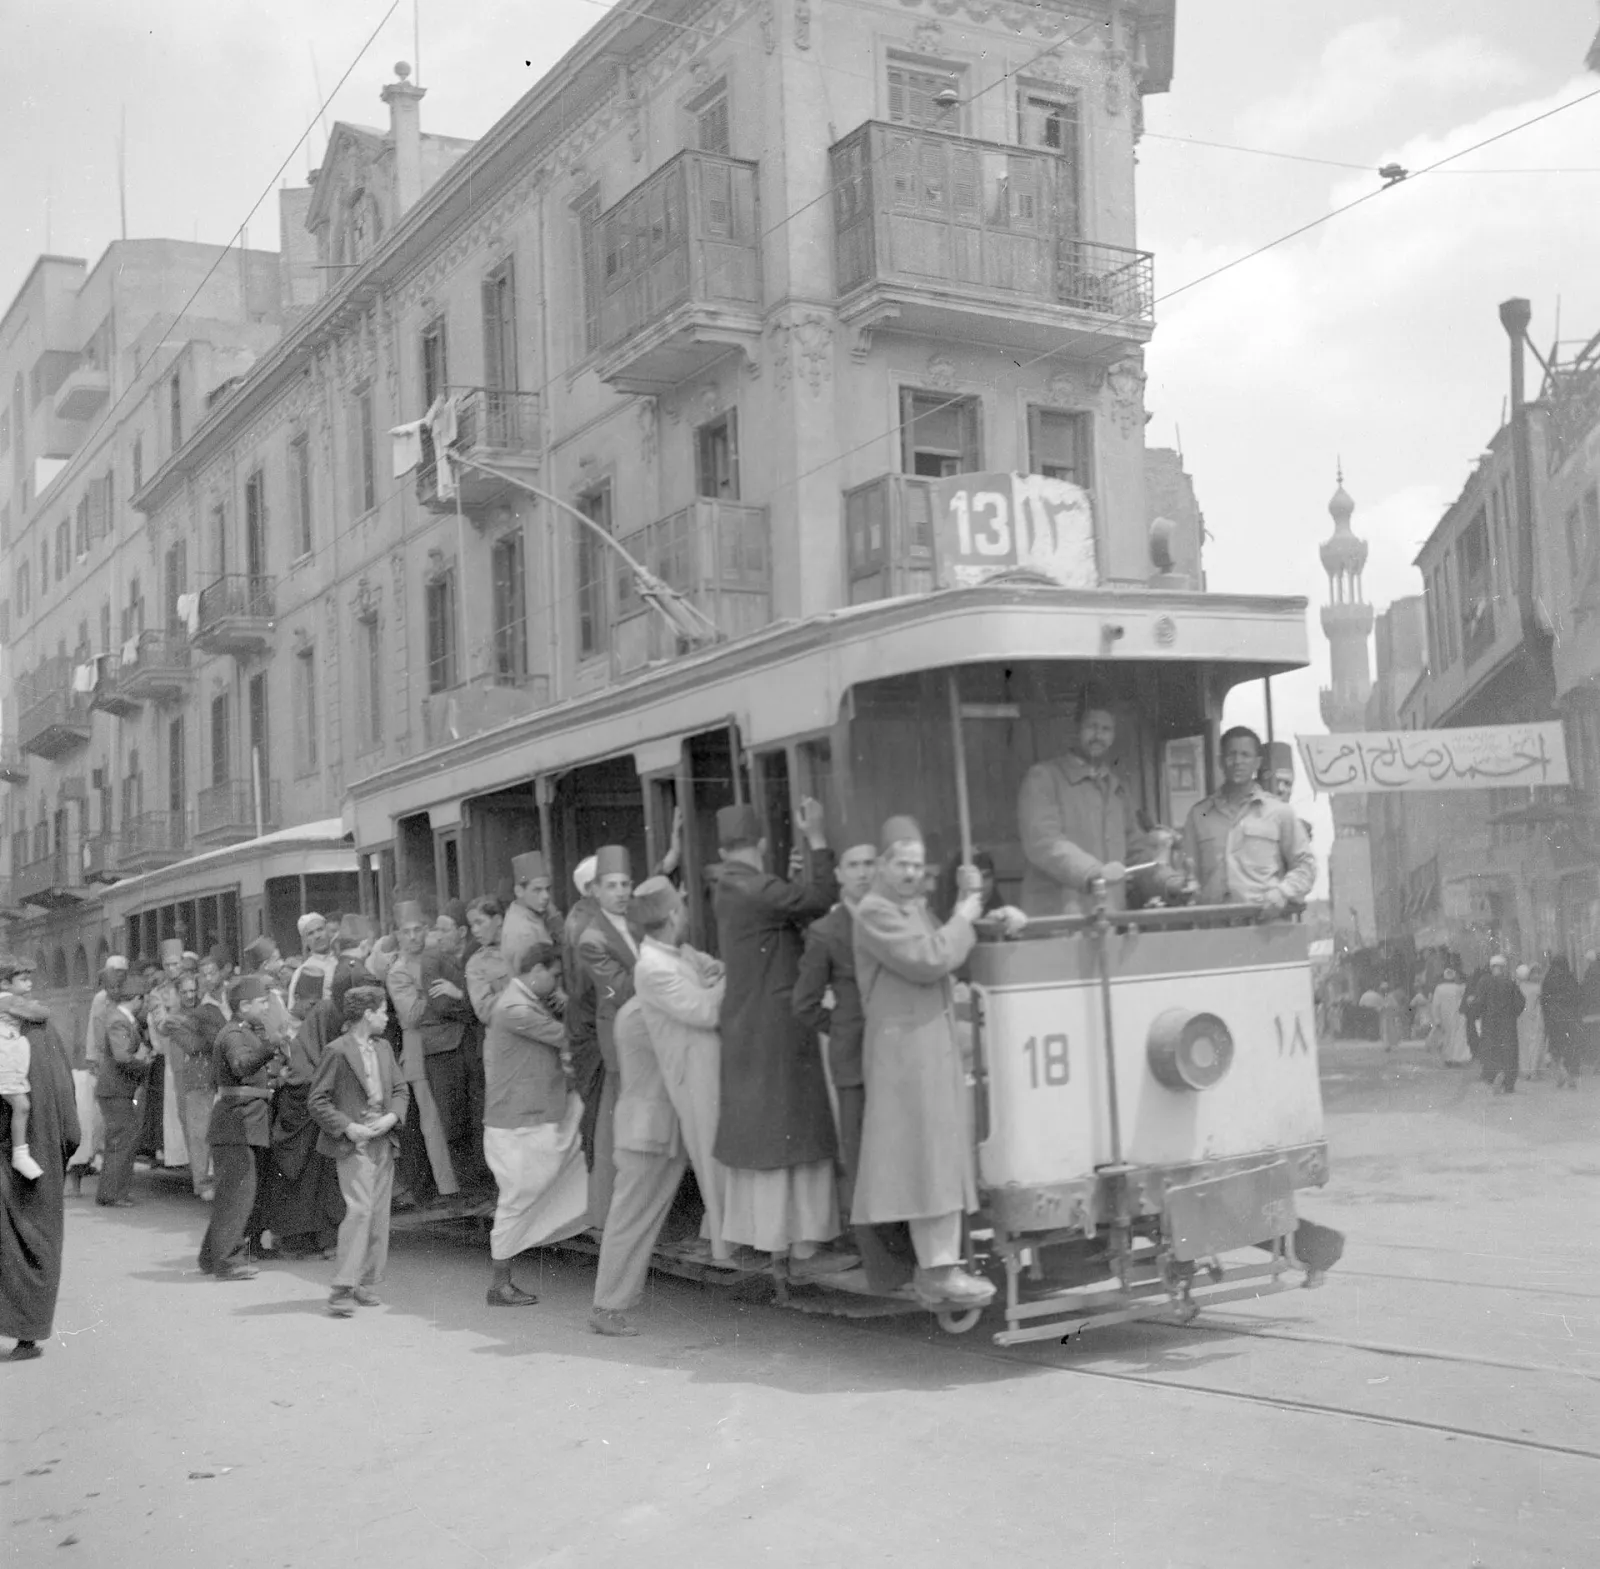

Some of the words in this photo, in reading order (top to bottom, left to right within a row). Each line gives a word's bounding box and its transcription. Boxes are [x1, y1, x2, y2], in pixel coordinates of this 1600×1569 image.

[950, 490, 1011, 555] 13
[1023, 1033, 1070, 1089] 18
[1273, 1014, 1309, 1058] ١٨
